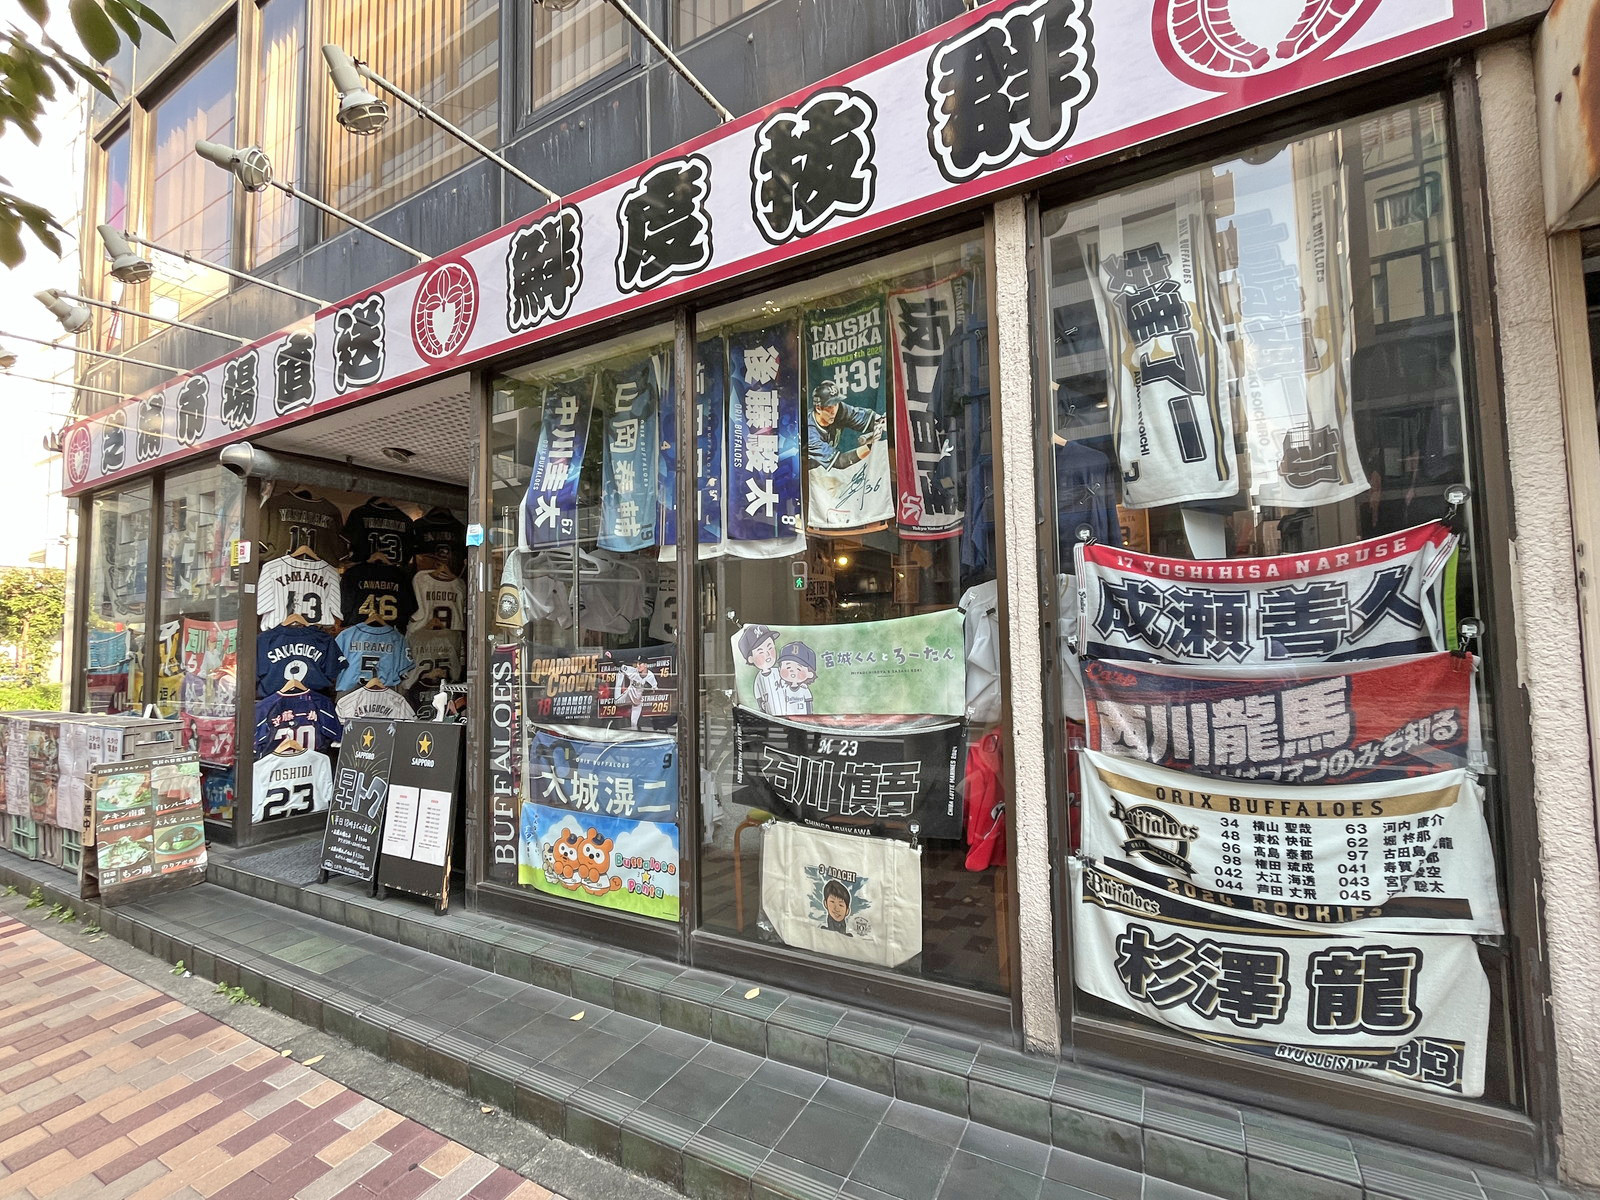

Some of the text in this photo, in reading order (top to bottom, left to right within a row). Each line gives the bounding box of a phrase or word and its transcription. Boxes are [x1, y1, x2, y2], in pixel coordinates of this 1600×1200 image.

[506, 0, 1099, 332] 鮮度抜群
[1180, 240, 1192, 285] BUFFALOES
[811, 308, 880, 342] TAISHI
[812, 327, 881, 360] HIROOKA
[823, 354, 854, 366] NOVEMBER
[101, 291, 385, 475] 芝浦市場直送
[734, 403, 743, 468] ORIX BUFFALOES
[744, 345, 780, 517] 後藤駿太
[534, 396, 579, 529] 中川圭太
[610, 382, 641, 537] 山岡泰輔
[533, 457, 546, 491] BUFFALOES
[561, 518, 573, 535] 67
[1117, 537, 1407, 579] 17 YOSHIHISA NARUSE
[359, 594, 398, 620] 46
[1092, 565, 1427, 662] 成瀬善久
[268, 643, 322, 664] SAKAGUCHI
[351, 641, 393, 655] HIRANO
[821, 647, 955, 668] 宮城くんとろーたん
[187, 653, 198, 673] 5
[360, 655, 380, 684] 5
[531, 655, 599, 684] QUADRUPLE
[660, 668, 670, 678] 15
[547, 674, 598, 697] CROWN
[537, 698, 552, 716] 18
[553, 695, 593, 706] YAMAMOTO
[641, 694, 669, 702] STRIKEOUT
[652, 702, 669, 713] 205
[552, 705, 592, 716] YOSHINOBU
[355, 751, 375, 760] SAPPORO
[838, 740, 859, 756] 23
[411, 757, 435, 767] SAPPORO
[493, 661, 516, 865] BUFFALOES
[593, 760, 630, 769] BUFFALOES
[662, 753, 672, 769] 9
[269, 765, 313, 782] YOSHIDA
[761, 746, 921, 817] 石川慎吾
[263, 783, 314, 820] 23
[336, 767, 388, 819] 早トク
[542, 766, 670, 817] 大城滉二
[1156, 787, 1384, 817] ORIX BUFFALOES
[102, 808, 146, 821] チキン南蛮
[1109, 795, 1200, 842] Buffaloes
[1220, 818, 1240, 828] 34
[1252, 821, 1279, 833] 横山
[1345, 824, 1367, 834] 63
[1383, 821, 1411, 833] 河内
[1221, 831, 1313, 848] 48 東松 快征
[1346, 837, 1368, 848] 62
[1383, 836, 1397, 846] 堀
[1222, 843, 1241, 854] 96
[1286, 849, 1314, 861] 泰都
[1347, 846, 1426, 861] 97 古田島
[122, 865, 152, 878] もつ鍋
[161, 858, 200, 870] のりアボカ
[615, 853, 676, 875] Buffaloes
[818, 864, 857, 883] 3 ADACHI
[1222, 855, 1315, 874] 98 権田 琉成
[1338, 861, 1412, 874] 041 寿賀
[1214, 866, 1316, 887] 042 大江 海透
[1338, 876, 1370, 887] 043
[628, 879, 664, 899] Ponta
[1086, 867, 1160, 916] Buffaloes
[1167, 878, 1235, 907] 2024
[1215, 878, 1317, 900] 044 芦田 丈飛
[1339, 890, 1371, 901] 045
[1115, 922, 1423, 1037] 杉澤 龍
[1275, 1043, 1303, 1061] RYU
[1387, 1037, 1460, 1087] 33
